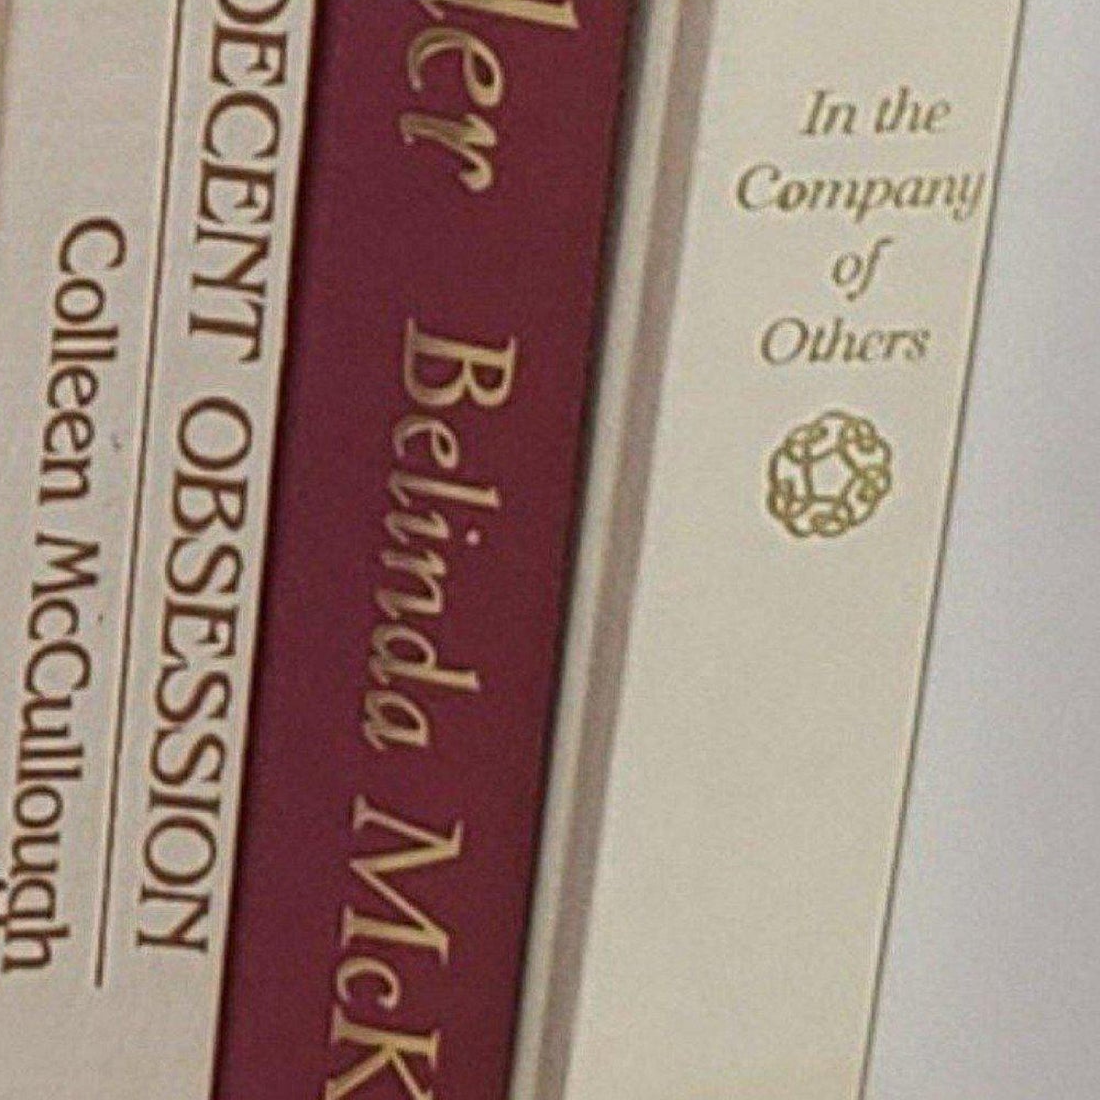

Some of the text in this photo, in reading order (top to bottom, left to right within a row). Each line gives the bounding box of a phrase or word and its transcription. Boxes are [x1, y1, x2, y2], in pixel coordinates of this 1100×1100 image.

[801, 84, 951, 136] In the
[736, 161, 986, 224] Company
[831, 235, 895, 302] of
[38, 217, 128, 506] Colleen
[760, 315, 932, 367] Others
[363, 317, 517, 752] Belinda
[135, 395, 253, 954] OBSESSION
